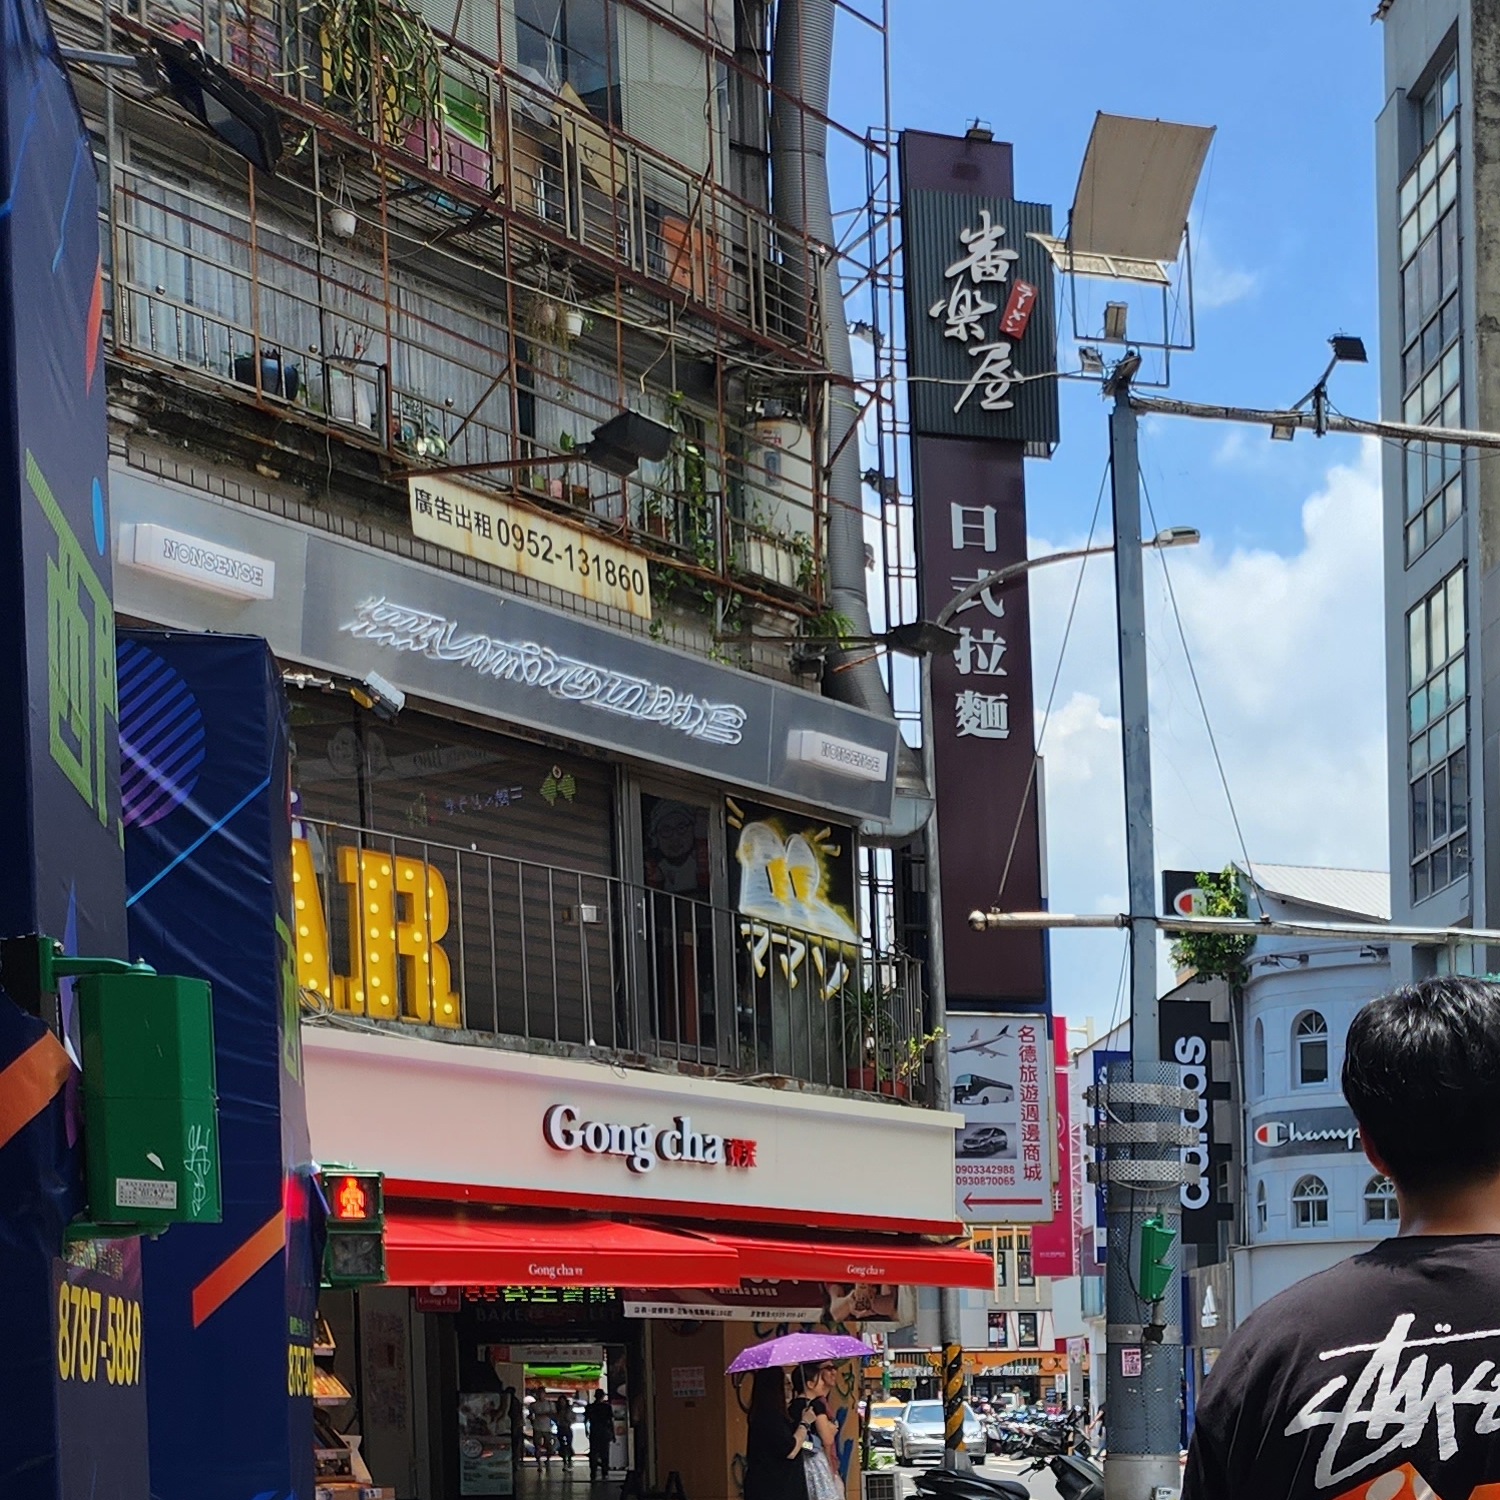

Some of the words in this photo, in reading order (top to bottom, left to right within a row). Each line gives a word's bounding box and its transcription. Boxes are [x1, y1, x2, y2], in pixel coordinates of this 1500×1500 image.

[163, 539, 264, 586] NONSENSE
[414, 486, 492, 541] 廣告出租
[496, 517, 645, 597] 0952-131860
[950, 501, 1010, 740] 日式拉麵
[821, 740, 880, 773] NONSENSE
[1017, 1024, 1043, 1182] 名德旅遊週邊商城
[545, 1104, 656, 1174] Gong
[660, 1116, 727, 1166] cha
[955, 1165, 1016, 1176] 0903342988
[955, 1176, 1017, 1187] 0930870065
[528, 1264, 556, 1279] Gong
[557, 1264, 574, 1276] cha
[847, 1264, 869, 1278] Gong
[57, 1280, 142, 1387] 8787-5869
